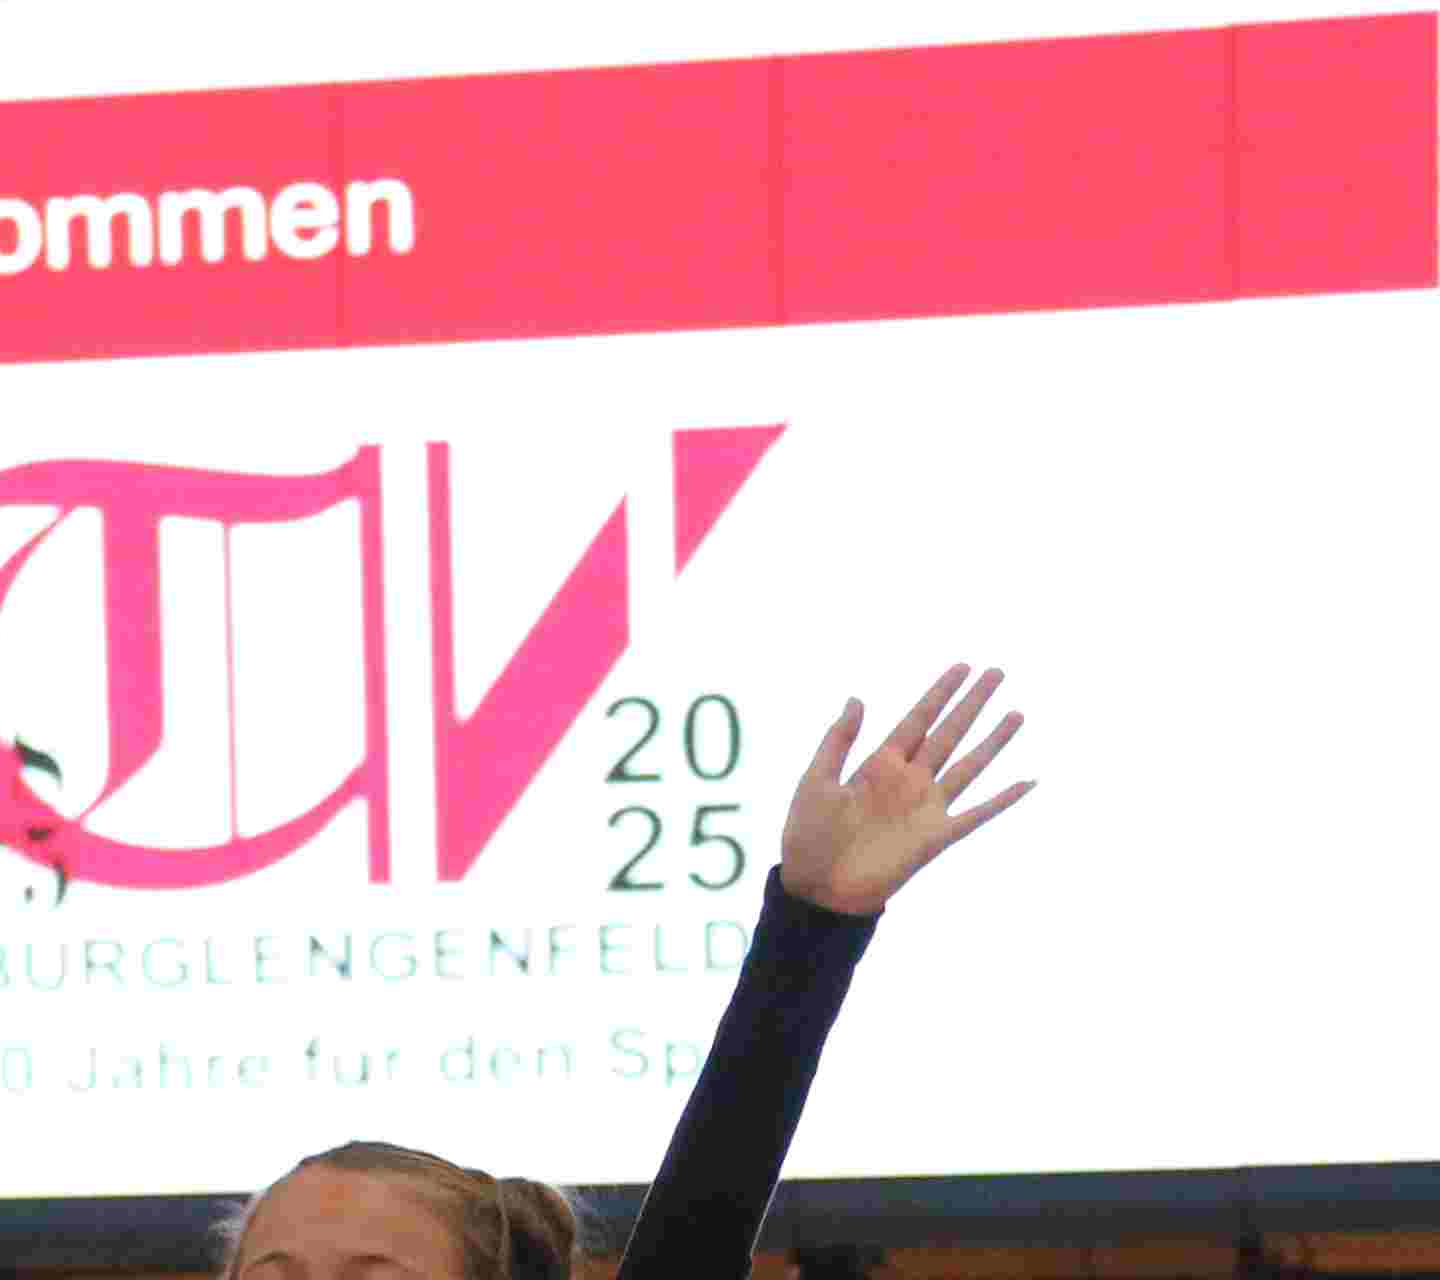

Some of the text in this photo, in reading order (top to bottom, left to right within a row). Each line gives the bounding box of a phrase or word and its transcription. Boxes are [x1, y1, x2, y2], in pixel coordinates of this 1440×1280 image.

[604, 693, 743, 785] 20
[605, 803, 748, 893] 25
[68, 1039, 273, 1093] Jahre
[438, 1033, 577, 1088] den
